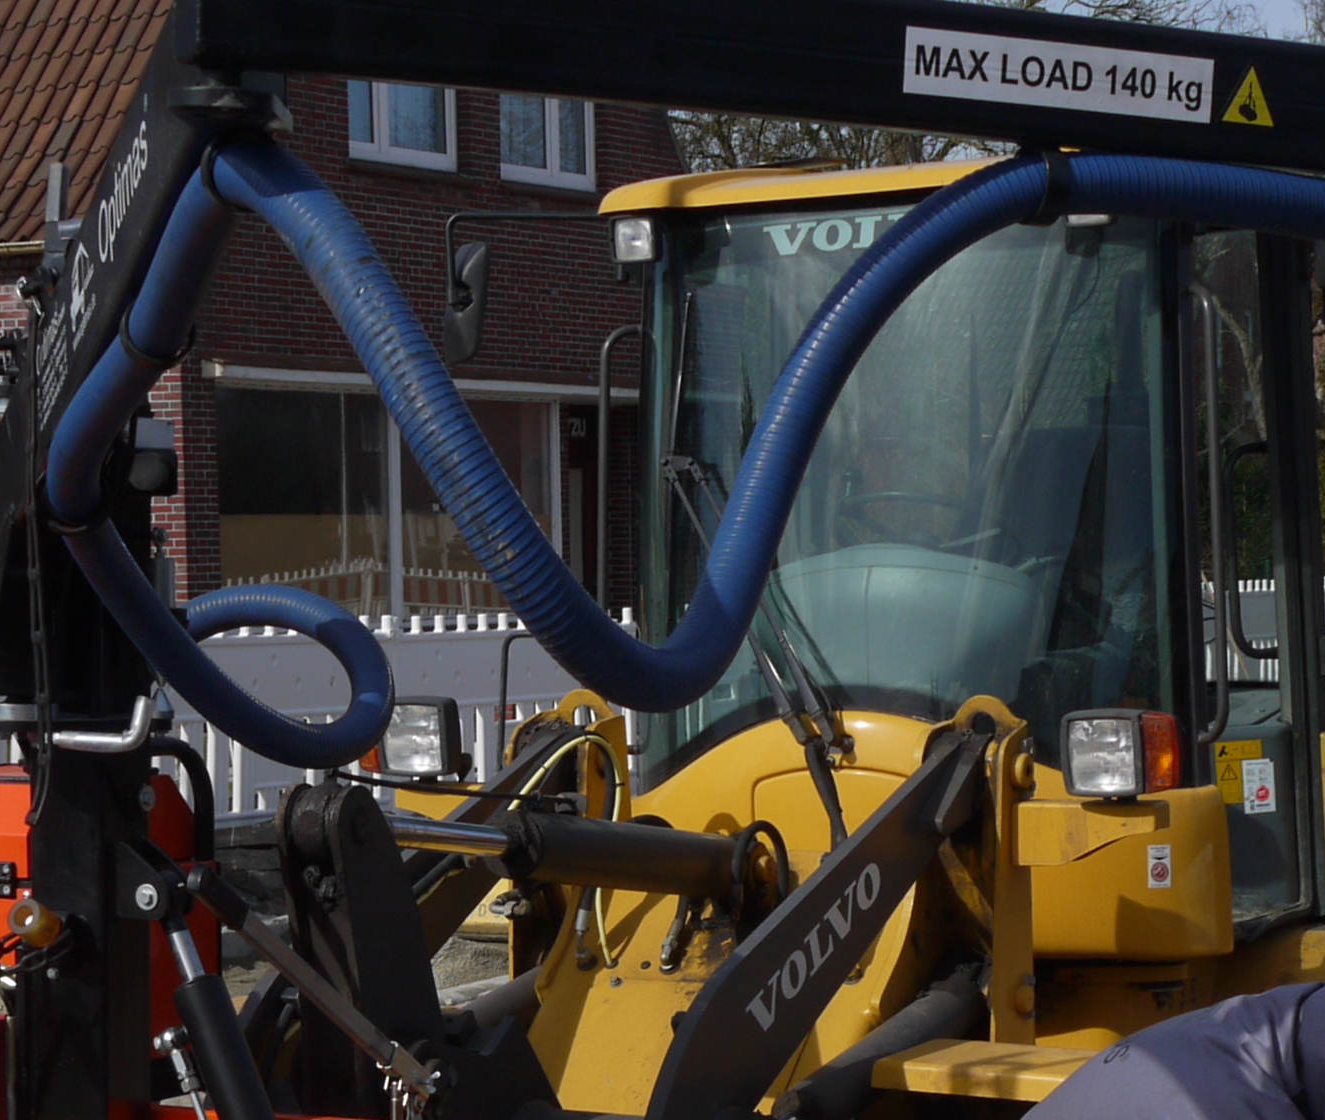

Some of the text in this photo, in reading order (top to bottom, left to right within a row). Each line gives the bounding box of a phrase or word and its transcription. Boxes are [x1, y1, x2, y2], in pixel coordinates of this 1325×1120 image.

[914, 44, 1203, 111] MAX LOAD 140 kg
[98, 119, 148, 263] Optimas
[762, 213, 906, 257] VOL
[745, 862, 881, 1032] VOLVO
